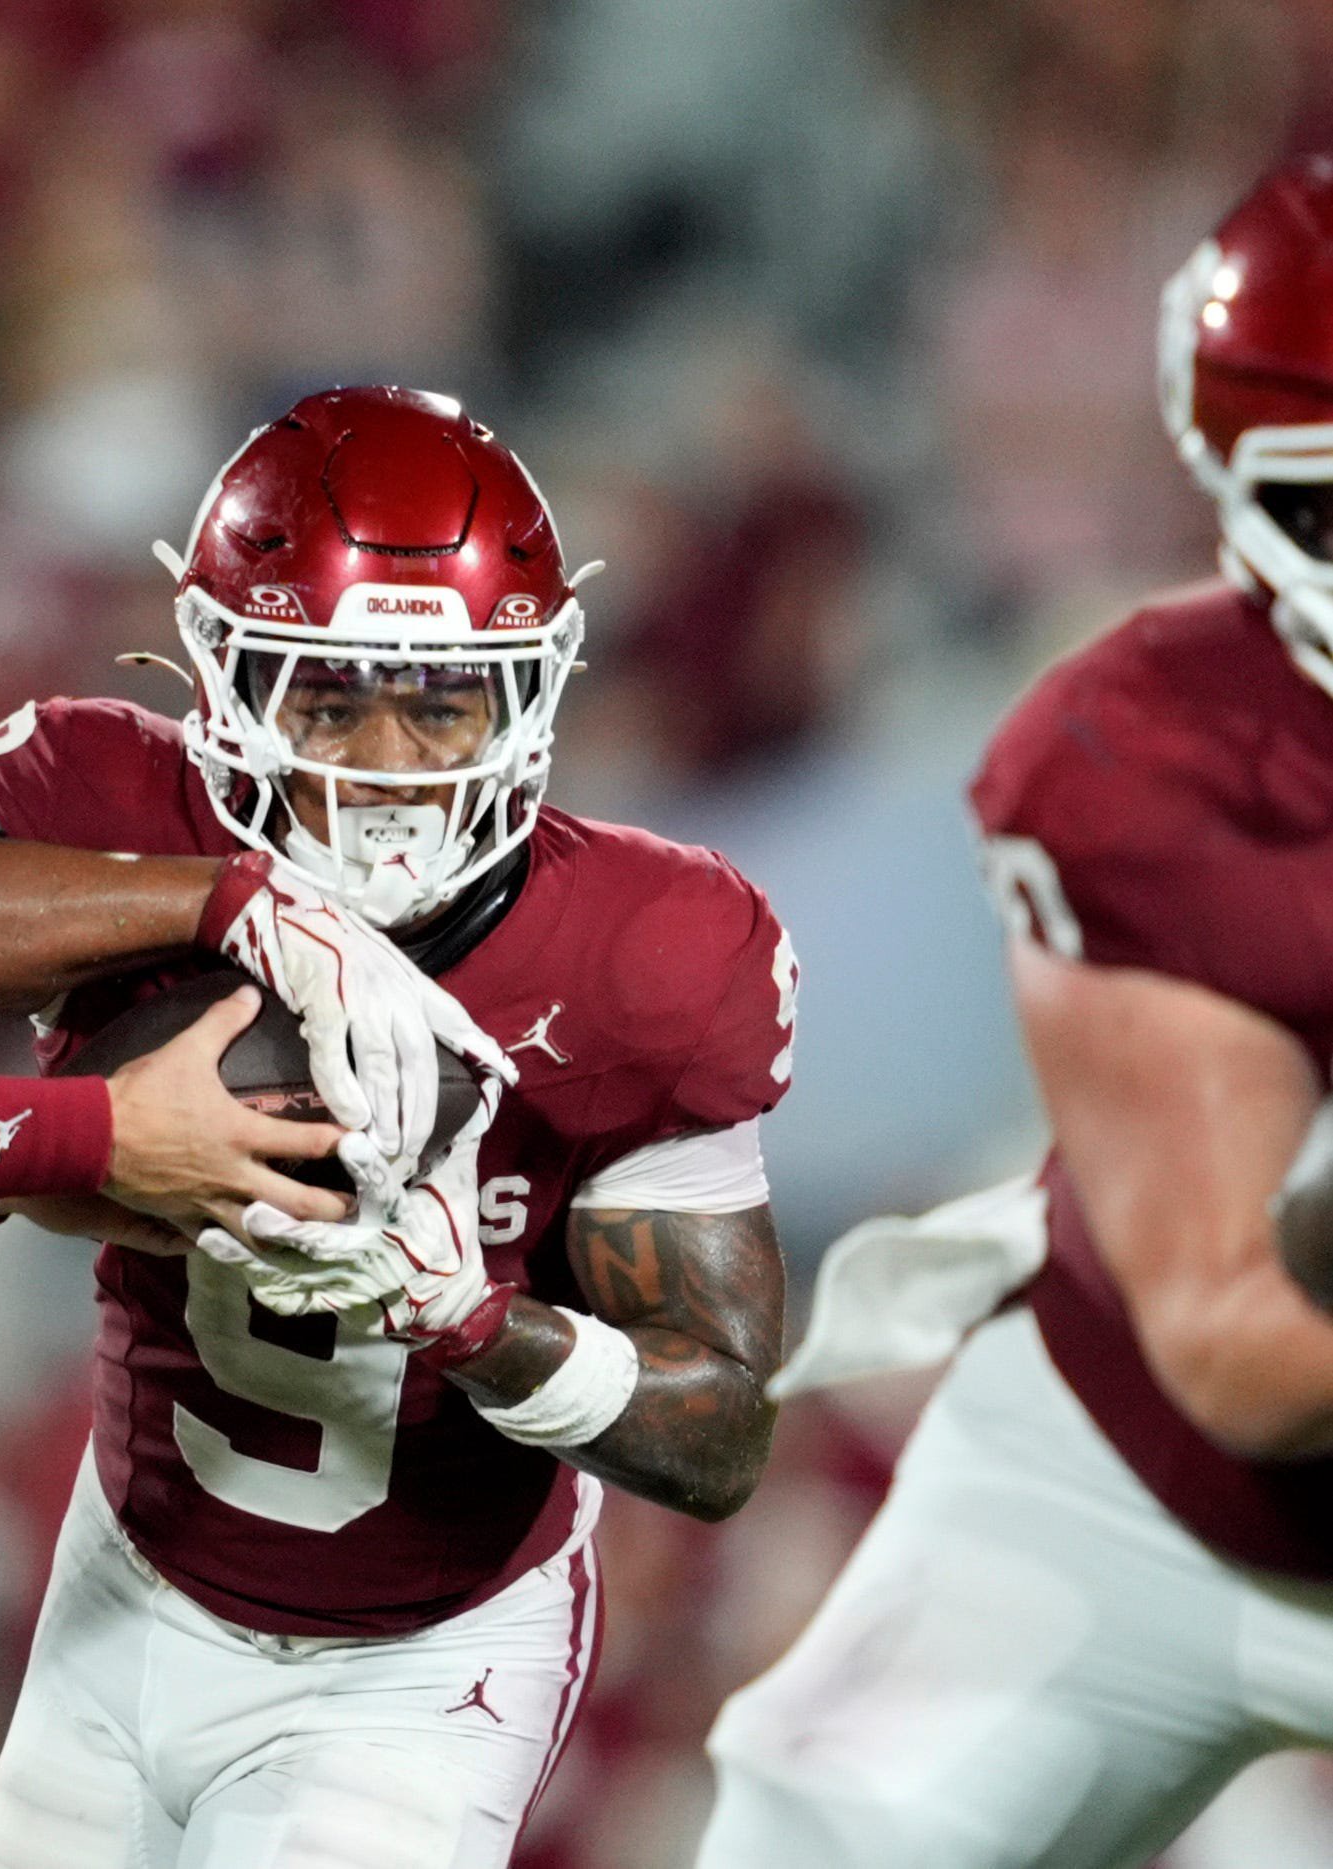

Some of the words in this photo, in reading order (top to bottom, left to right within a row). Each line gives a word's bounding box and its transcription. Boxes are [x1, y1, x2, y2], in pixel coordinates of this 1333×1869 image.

[245, 603, 298, 618] OAKLEY
[366, 597, 444, 616] OKLAHOMA
[496, 615, 541, 627] OAKLEY
[173, 1248, 408, 1534] 9
